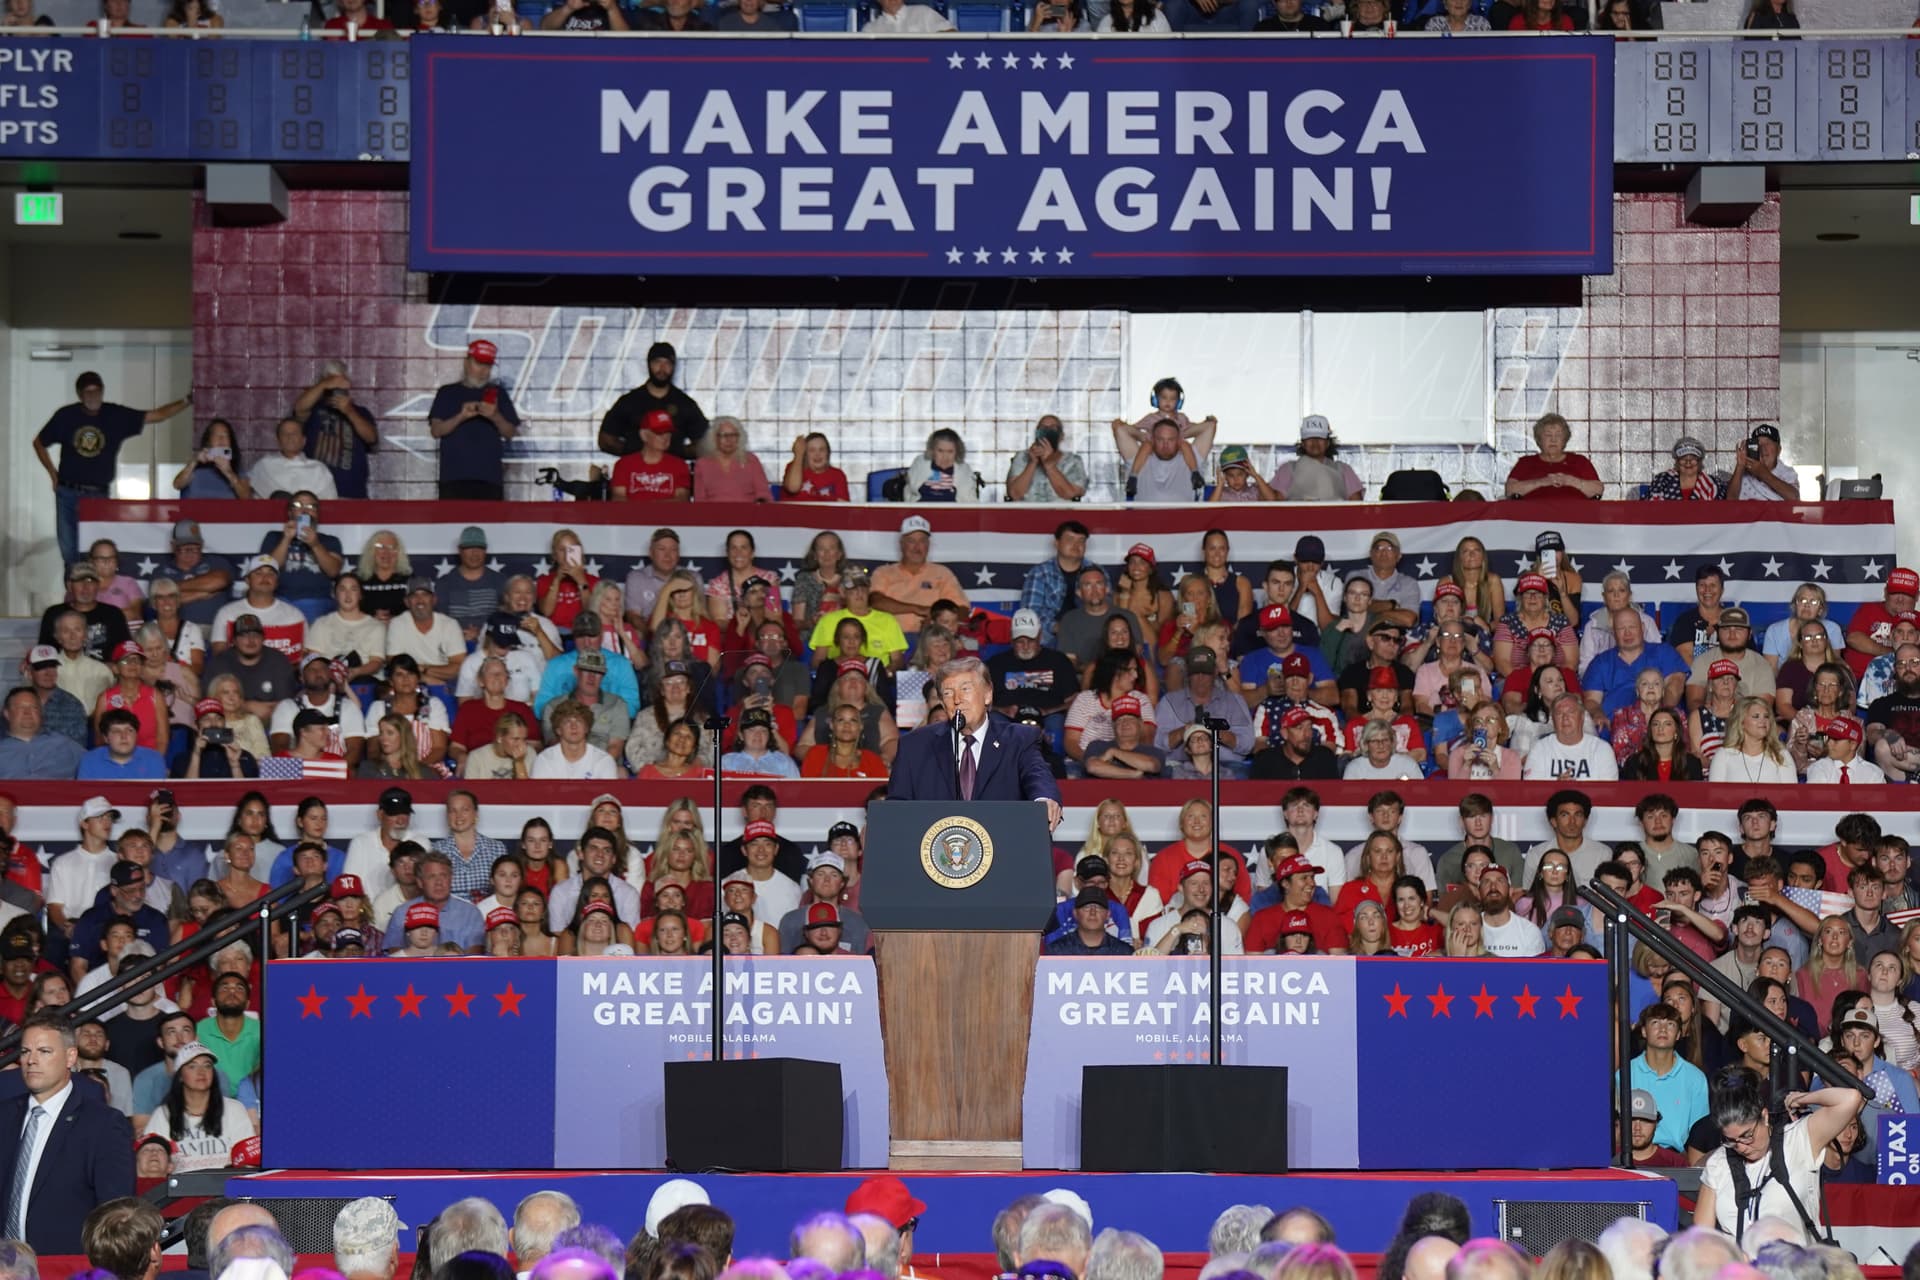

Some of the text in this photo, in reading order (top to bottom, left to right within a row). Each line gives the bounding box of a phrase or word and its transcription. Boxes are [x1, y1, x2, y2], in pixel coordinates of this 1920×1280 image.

[0, 50, 73, 72] PLYR
[0, 85, 58, 108] FLS
[0, 121, 58, 144] PTS
[600, 89, 1427, 156] MAKE AMERICA
[24, 196, 58, 223] EXIT
[628, 165, 1394, 233] GREAT AGAIN!
[1014, 617, 1035, 627] USA
[1551, 759, 1591, 778] USA
[582, 972, 863, 995] MAKE AMERICA
[1048, 972, 1329, 995] MAKE AMERICA
[593, 1002, 853, 1025] GREAT AGAIN!
[1060, 1002, 1321, 1025] GREAT AGAIN!
[669, 1034, 713, 1043] MOBILE
[1136, 1034, 1244, 1044] MOBILE, ALAAMA
[179, 1139, 230, 1155] AMILY
[1888, 1120, 1906, 1166] TAX
[1909, 1154, 1920, 1174] ON
